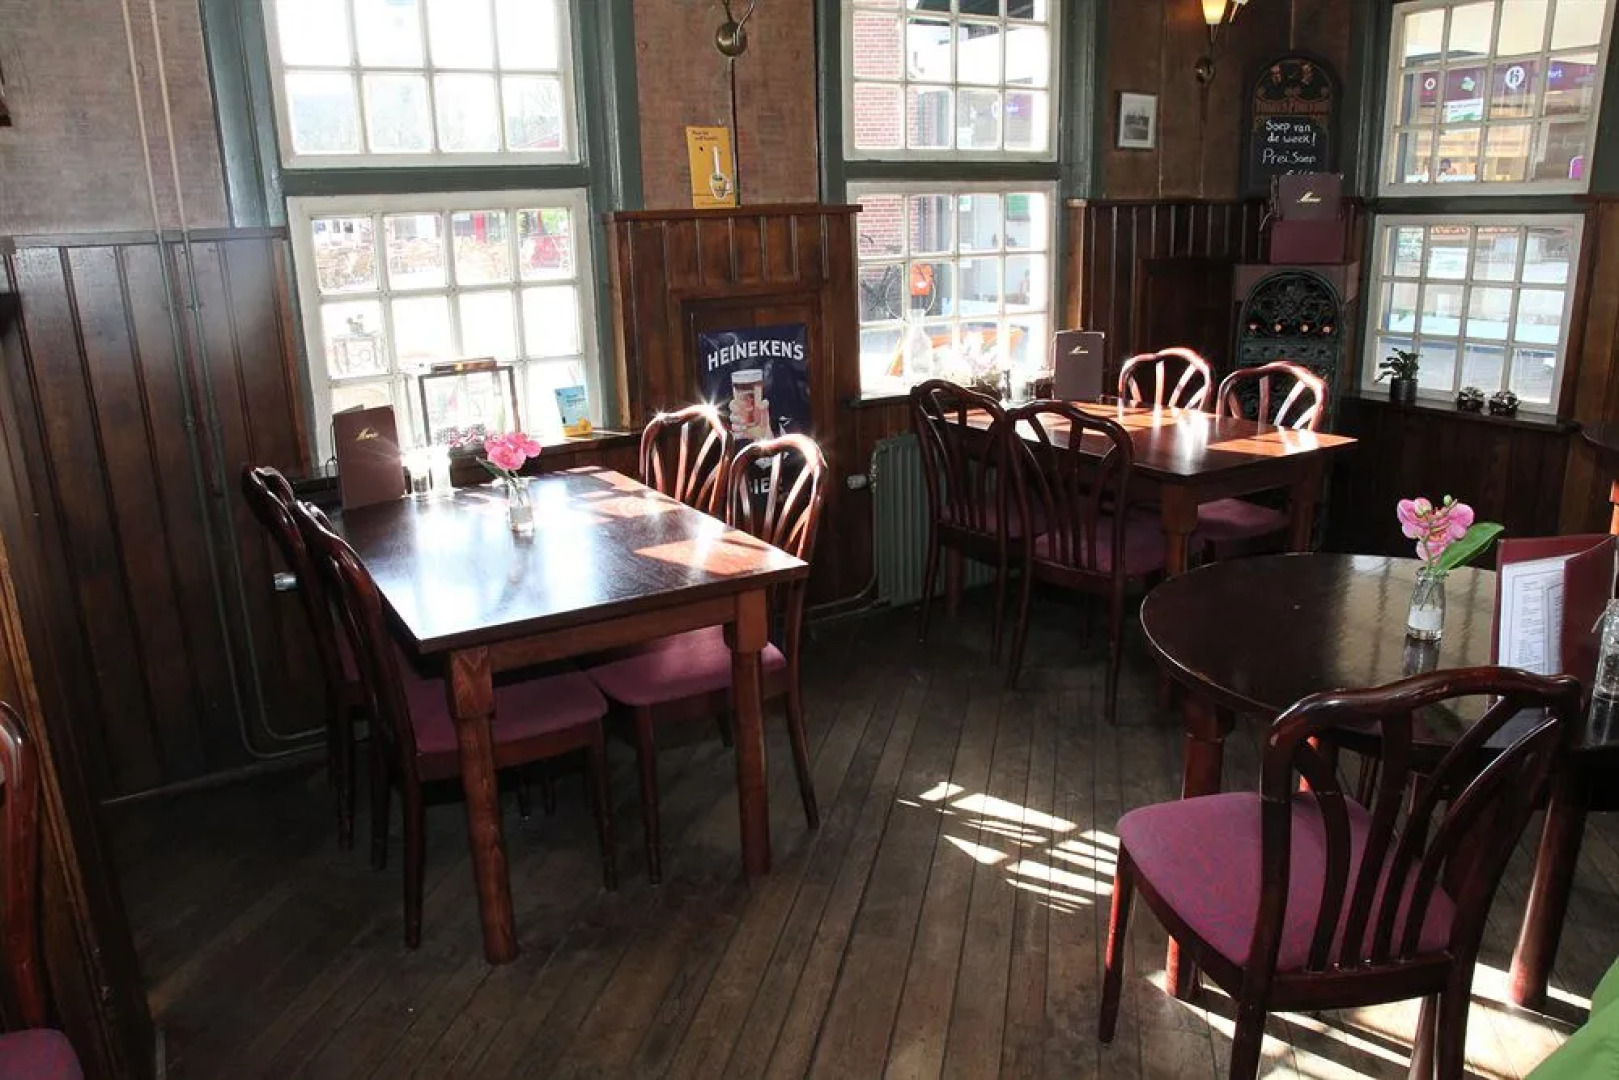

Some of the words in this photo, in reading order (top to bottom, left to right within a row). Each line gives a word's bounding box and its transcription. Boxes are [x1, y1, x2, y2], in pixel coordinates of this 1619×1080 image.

[1265, 119, 1291, 133] Soep
[1294, 124, 1311, 132] van
[1267, 132, 1280, 143] de
[1283, 132, 1317, 147] week!
[707, 339, 804, 372] HEINEKEN'S
